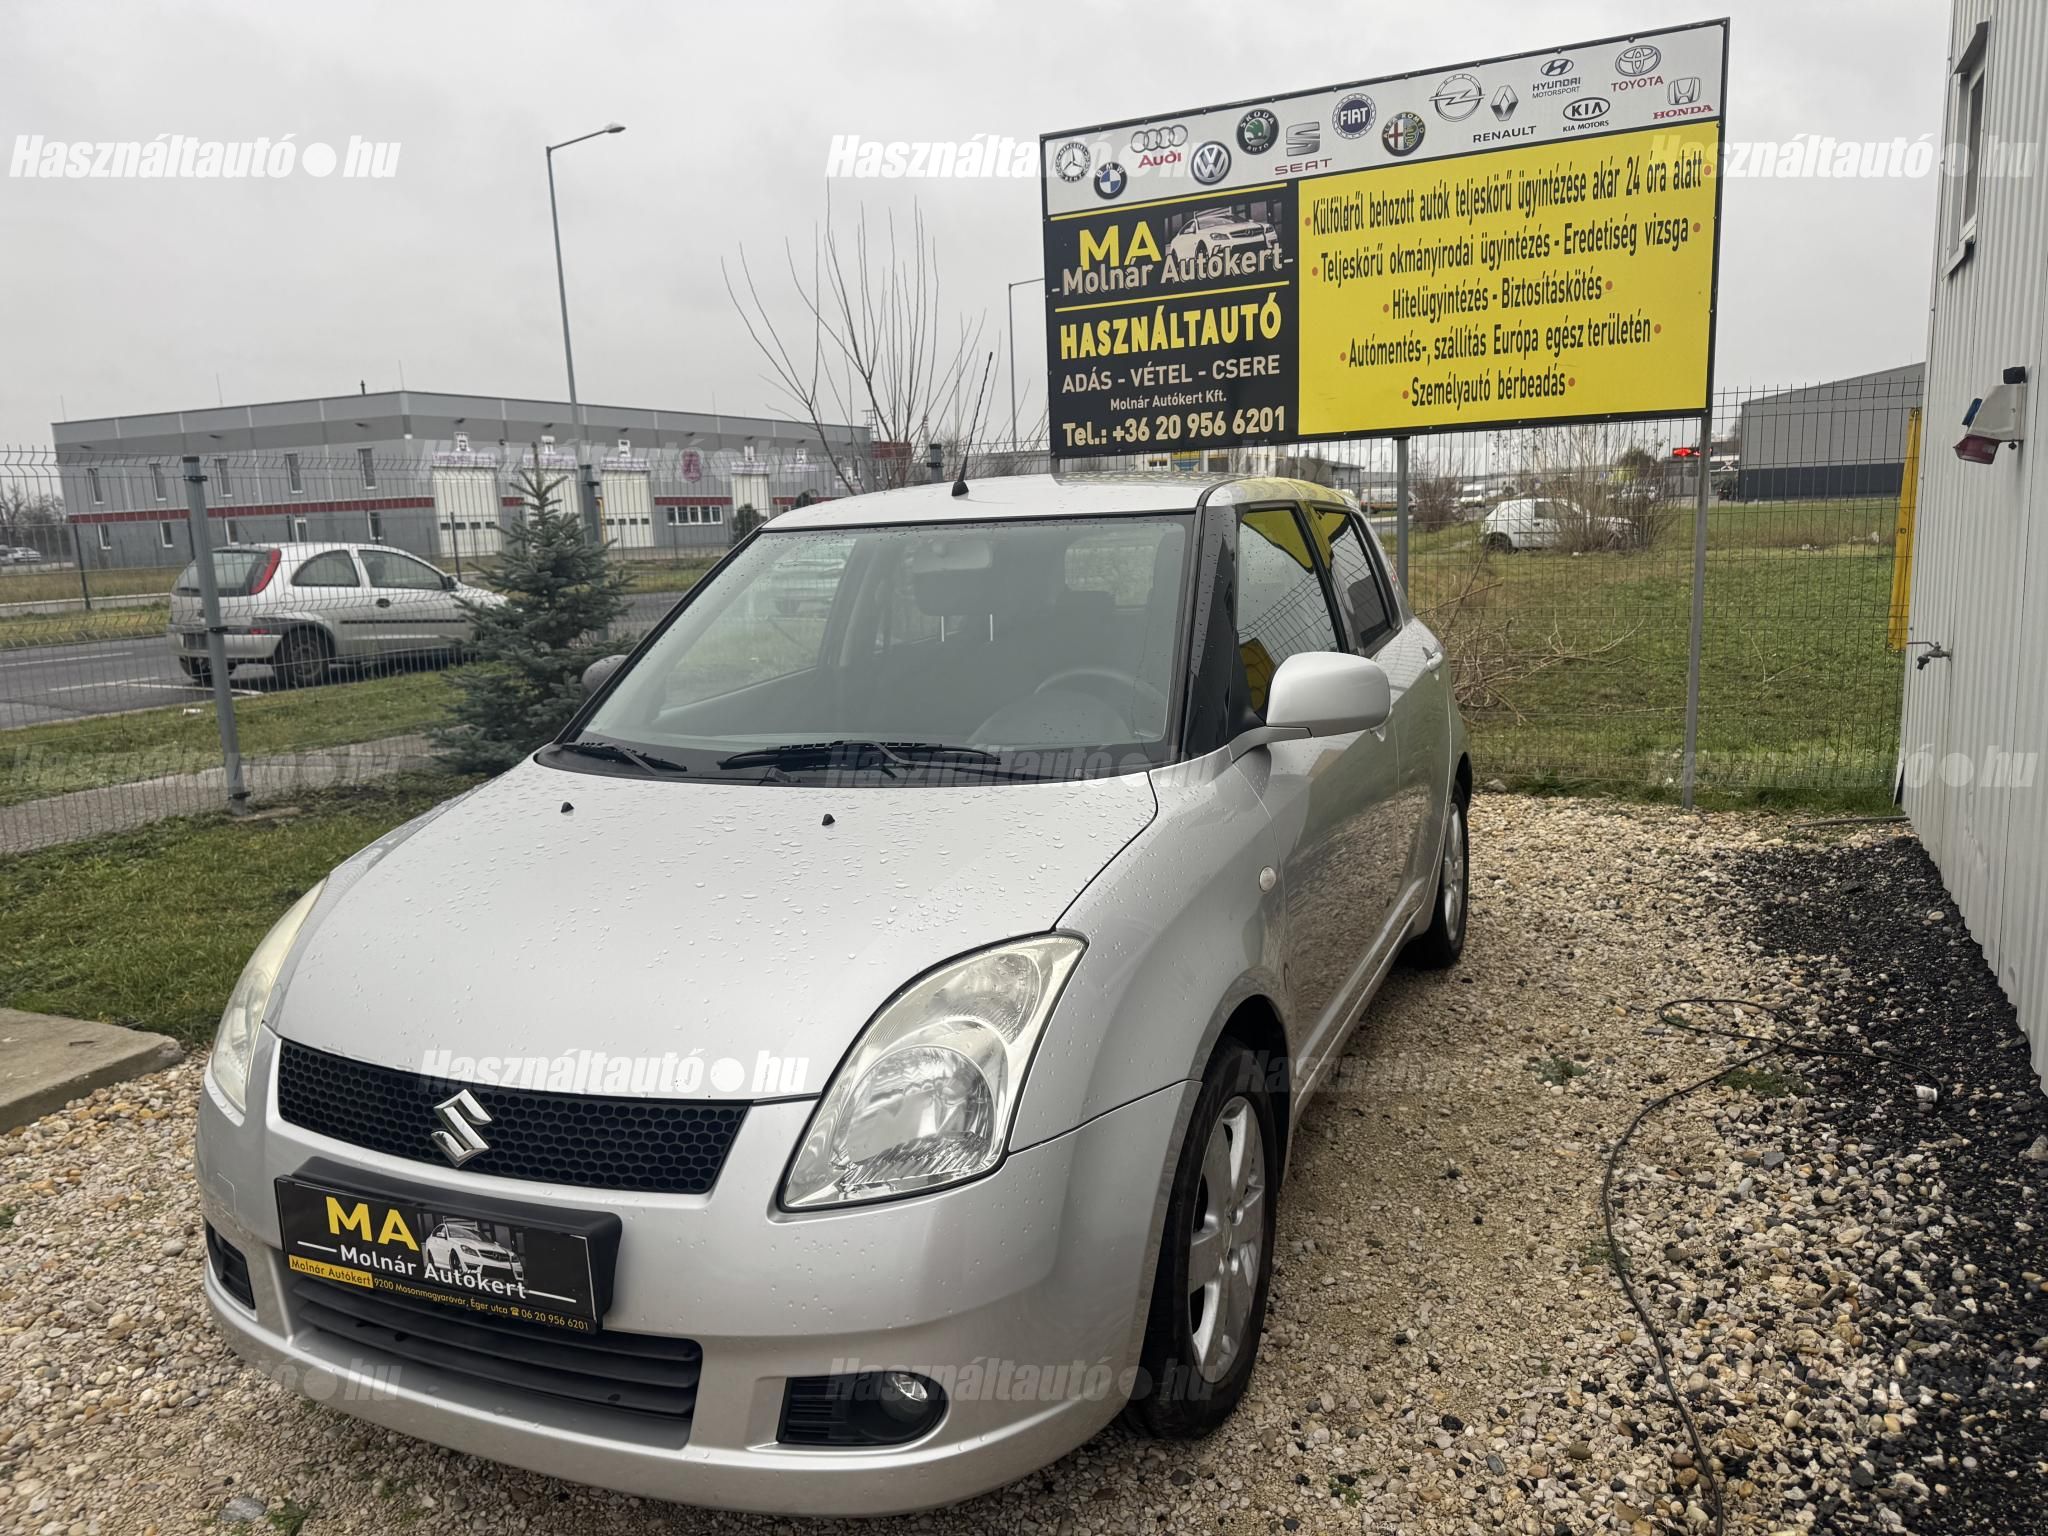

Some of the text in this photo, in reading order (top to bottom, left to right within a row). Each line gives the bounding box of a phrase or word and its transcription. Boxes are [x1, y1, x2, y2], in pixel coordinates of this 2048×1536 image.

[1532, 77, 1581, 91] HYUNDAI
[1532, 86, 1580, 99] MOTORSPORT
[1611, 75, 1664, 92] TOYOTA
[1340, 107, 1368, 126] FIAT
[1571, 103, 1603, 117] KIA
[1652, 104, 1714, 120] HONDA
[1401, 112, 1425, 134] ROMEO
[1473, 125, 1537, 143] RENAULT
[1563, 120, 1609, 132] KIA MOTORS
[1096, 162, 1125, 178] BMW
[1138, 150, 1182, 168] Audi
[1275, 158, 1332, 175] SEAT
[1313, 150, 1702, 236] Külföldről behozott autók teljeskörű ügyintézése akár 24 óra alatt
[1079, 220, 1162, 271] MA
[1321, 243, 1383, 288] Teljeskörű
[1390, 234, 1474, 277] okmányirodai
[1481, 223, 1550, 271] ügyintézés
[1564, 213, 1637, 256] Eredetiség
[1645, 212, 1688, 252] vizsga
[1392, 278, 1488, 324] Hitelügyintézés
[1501, 265, 1602, 309] Biztosításkötés
[1060, 292, 1282, 360] HASZNÁLTAUTÓ
[1434, 323, 1487, 360] szállítás
[1493, 319, 1539, 360] Európa
[1545, 315, 1584, 358] egész
[1588, 308, 1651, 347] területén
[1062, 366, 1112, 393] ADÁS
[1130, 362, 1193, 387] VÉTEL
[1212, 354, 1280, 380] CSERE
[1412, 362, 1566, 411] Személyautó bérbeadás
[1110, 389, 1227, 411] Molnár Autókert Kft.
[1063, 405, 1285, 447] Tel.: +36 20 956 6201
[325, 1196, 420, 1252] MA
[340, 1244, 526, 1299] Molnár Autókert
[291, 1258, 324, 1275] Molnár
[328, 1268, 371, 1285] Autókert
[374, 1278, 394, 1290] 9200
[490, 1305, 508, 1314] utca
[521, 1310, 533, 1320] 06
[534, 1311, 546, 1322] 20
[548, 1314, 565, 1326] 956
[567, 1318, 589, 1331] 6201
